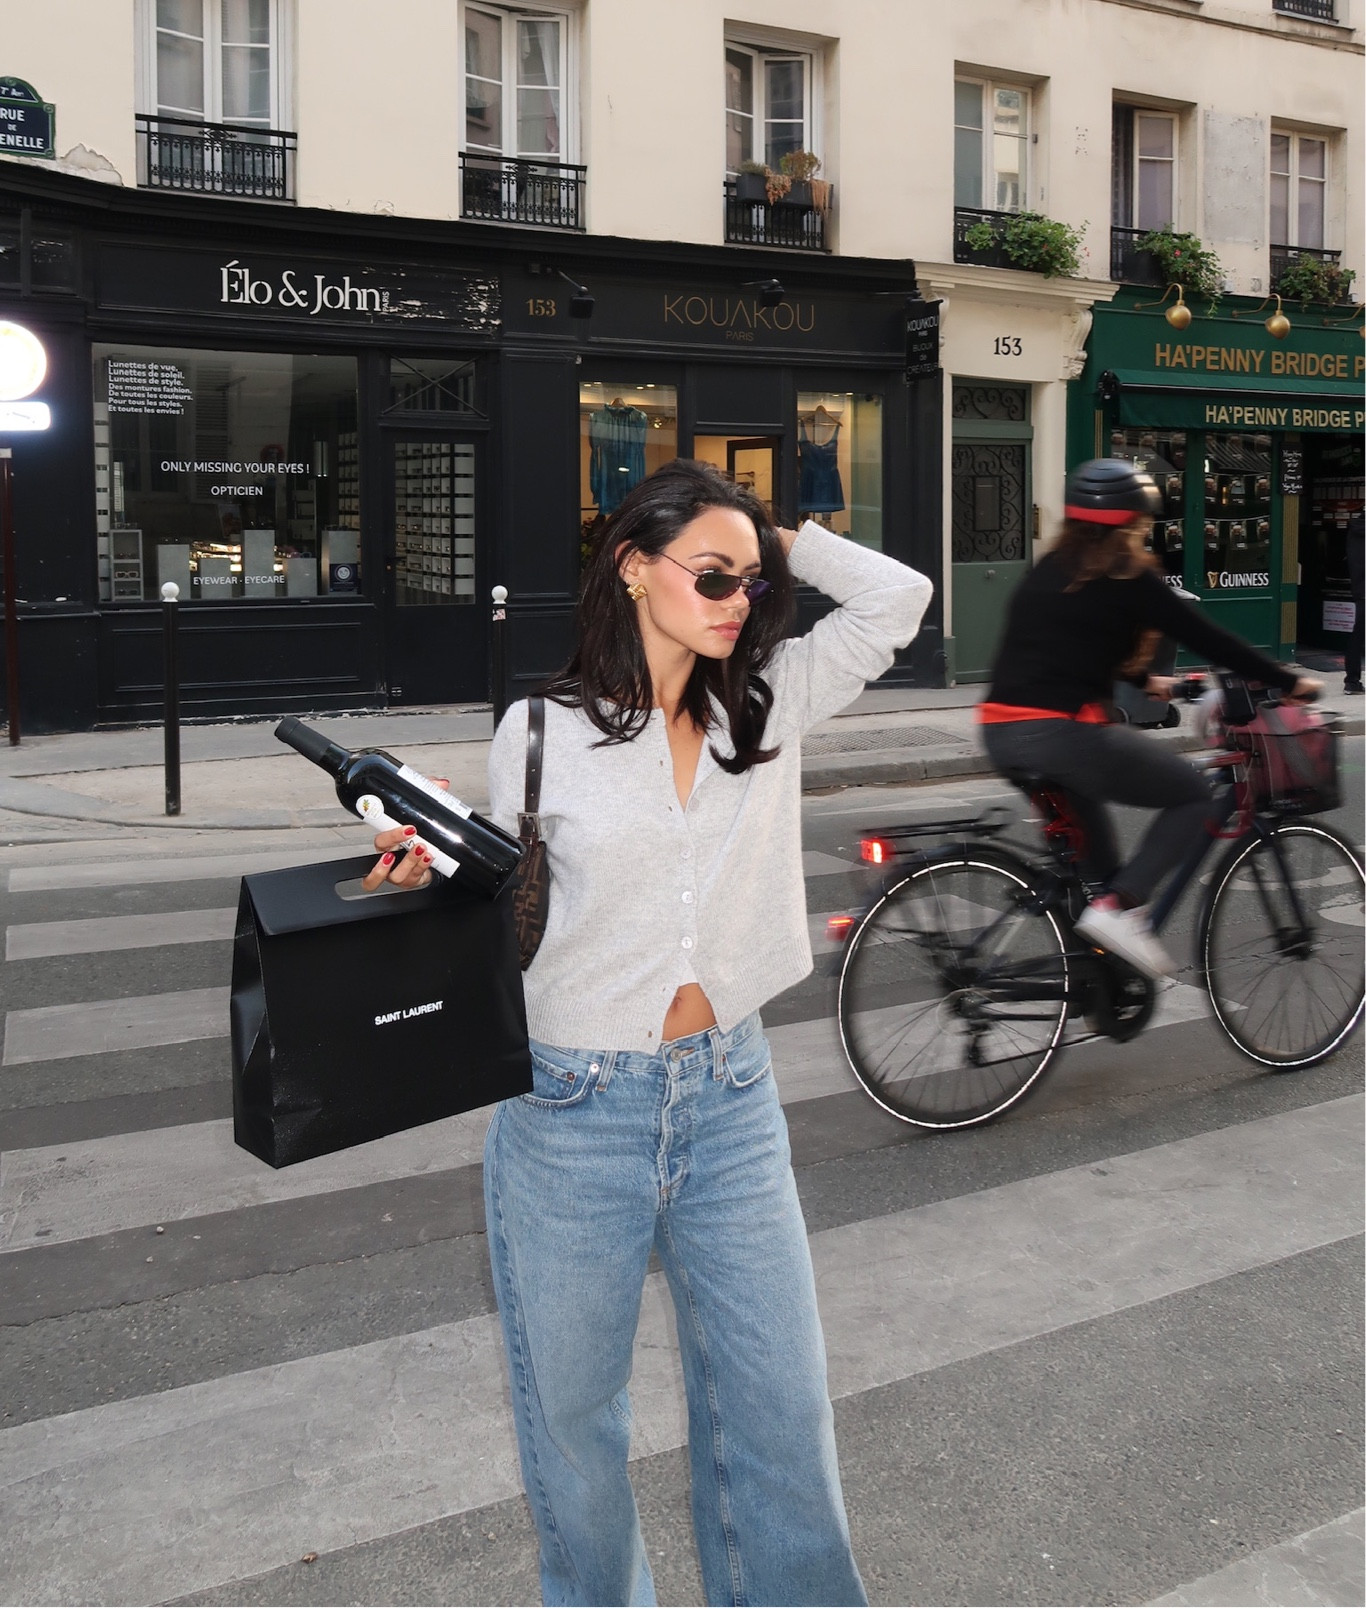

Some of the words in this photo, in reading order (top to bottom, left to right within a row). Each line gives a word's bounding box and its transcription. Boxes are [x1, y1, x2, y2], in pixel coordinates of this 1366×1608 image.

[0, 108, 25, 122] RUE
[220, 260, 273, 305] Élo
[279, 271, 309, 307] &
[310, 275, 382, 315] John
[382, 291, 390, 312] PARIS
[526, 299, 556, 317] 153
[665, 295, 815, 332] KOUAKOU
[726, 331, 754, 341] PARIS
[994, 336, 1022, 356] 153
[108, 360, 146, 369] Lunettes
[1155, 343, 1265, 373] HA'PENNY
[1271, 351, 1348, 378] BRIDGE
[108, 368, 146, 376] Lunettes
[109, 375, 147, 384] Lunettes
[161, 379, 183, 387] style.
[1205, 405, 1288, 426] HA'PENNY
[1293, 409, 1351, 428] BRIDGE
[161, 461, 191, 472] ONLY
[194, 462, 242, 473] MISSING
[245, 462, 275, 473] YOUR
[278, 463, 304, 474] EYES
[306, 463, 310, 474] !
[211, 486, 263, 496] OPTICIEN
[194, 577, 237, 585] EYEWEAR
[245, 576, 285, 584] EYECARE
[1220, 571, 1269, 587] GUINNESS
[375, 1011, 401, 1025] SAINT
[403, 1001, 443, 1019] LAURENT
